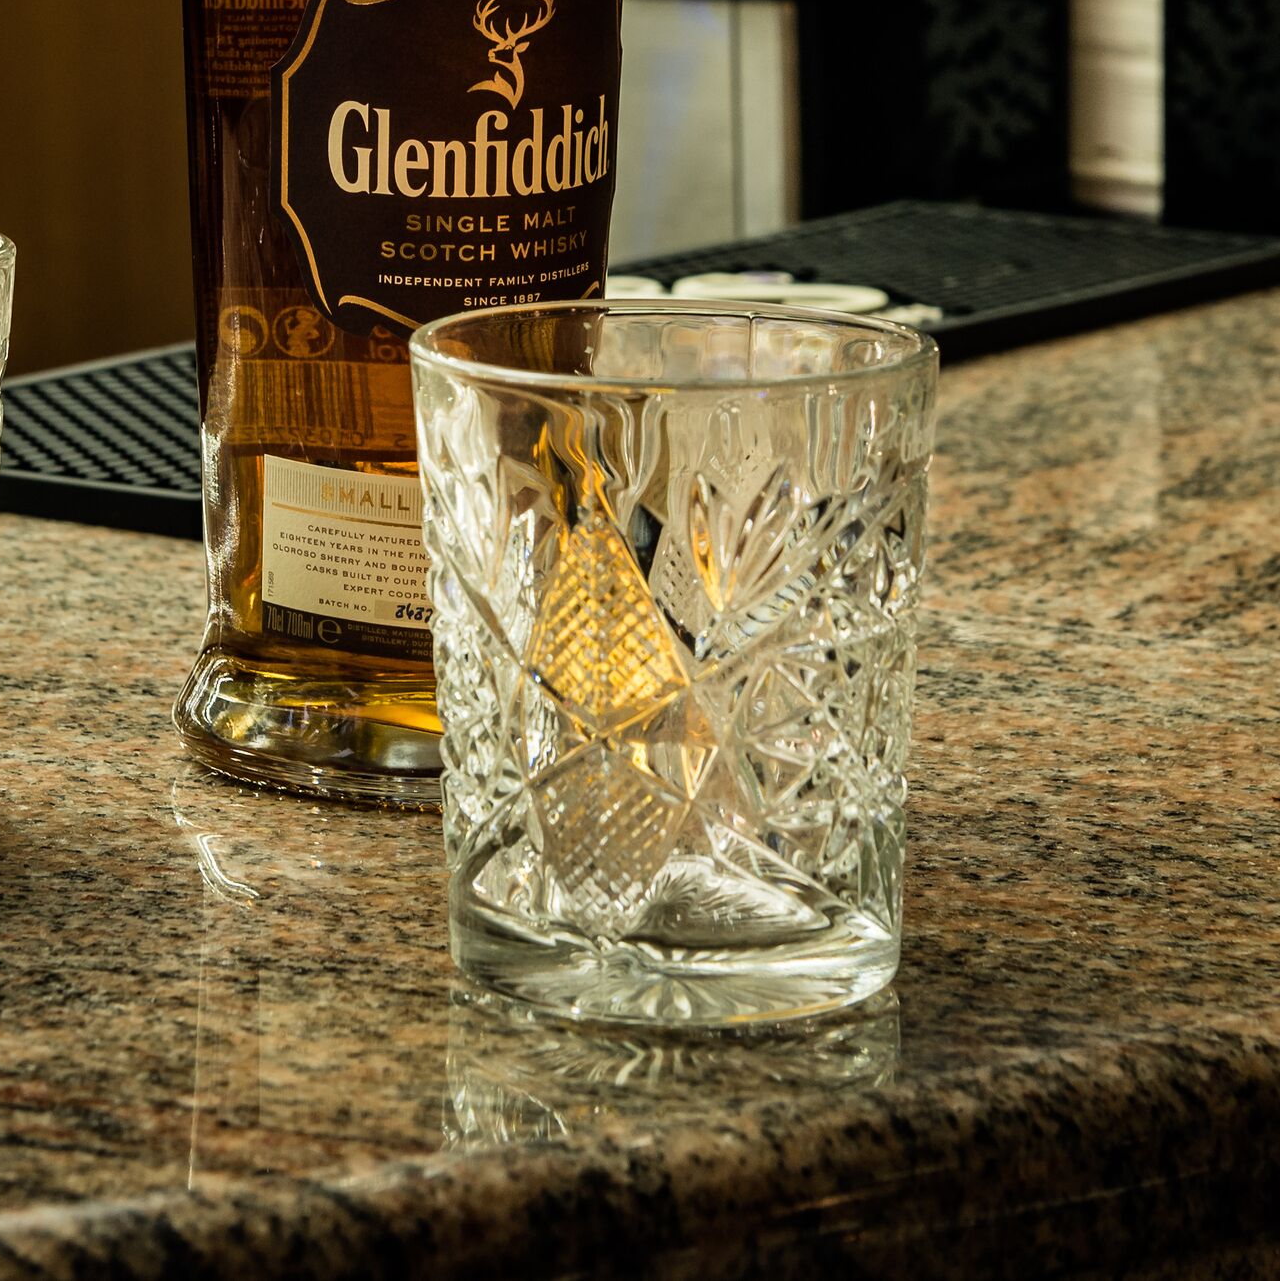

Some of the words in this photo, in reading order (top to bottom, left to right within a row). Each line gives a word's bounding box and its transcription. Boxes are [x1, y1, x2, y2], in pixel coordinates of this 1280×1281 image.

[327, 94, 609, 199] Glenfiddich
[406, 214, 510, 233] SINGLE
[524, 205, 576, 231] MALT
[380, 241, 496, 262] SCOTCH
[510, 230, 588, 261] WHISKY
[378, 274, 483, 288] INDEPENDENT
[489, 274, 535, 287] FAMILY
[540, 261, 590, 283] DISTILLERS
[463, 296, 507, 307] SINCE
[513, 292, 541, 304] 1887
[320, 482, 411, 511] SMALL
[279, 531, 326, 547] EIGHTEEN
[329, 543, 363, 554] YEARS
[367, 547, 379, 555] IN
[383, 549, 404, 559] THE
[307, 524, 365, 540] CAREFULLY
[369, 534, 421, 547] MATURED
[272, 543, 317, 559] OLOROSO
[320, 553, 361, 566] SHERRY
[364, 560, 386, 570] AND
[305, 564, 338, 577] CASKS
[342, 569, 371, 581] BUILT
[376, 575, 390, 585] BY
[394, 577, 417, 587] OUR
[318, 598, 350, 610] BATCH
[354, 603, 371, 613] NO.
[343, 584, 384, 597] EXPERT
[388, 590, 429, 601] COOPE
[267, 605, 284, 632] 70cl
[287, 610, 314, 639] 700ml
